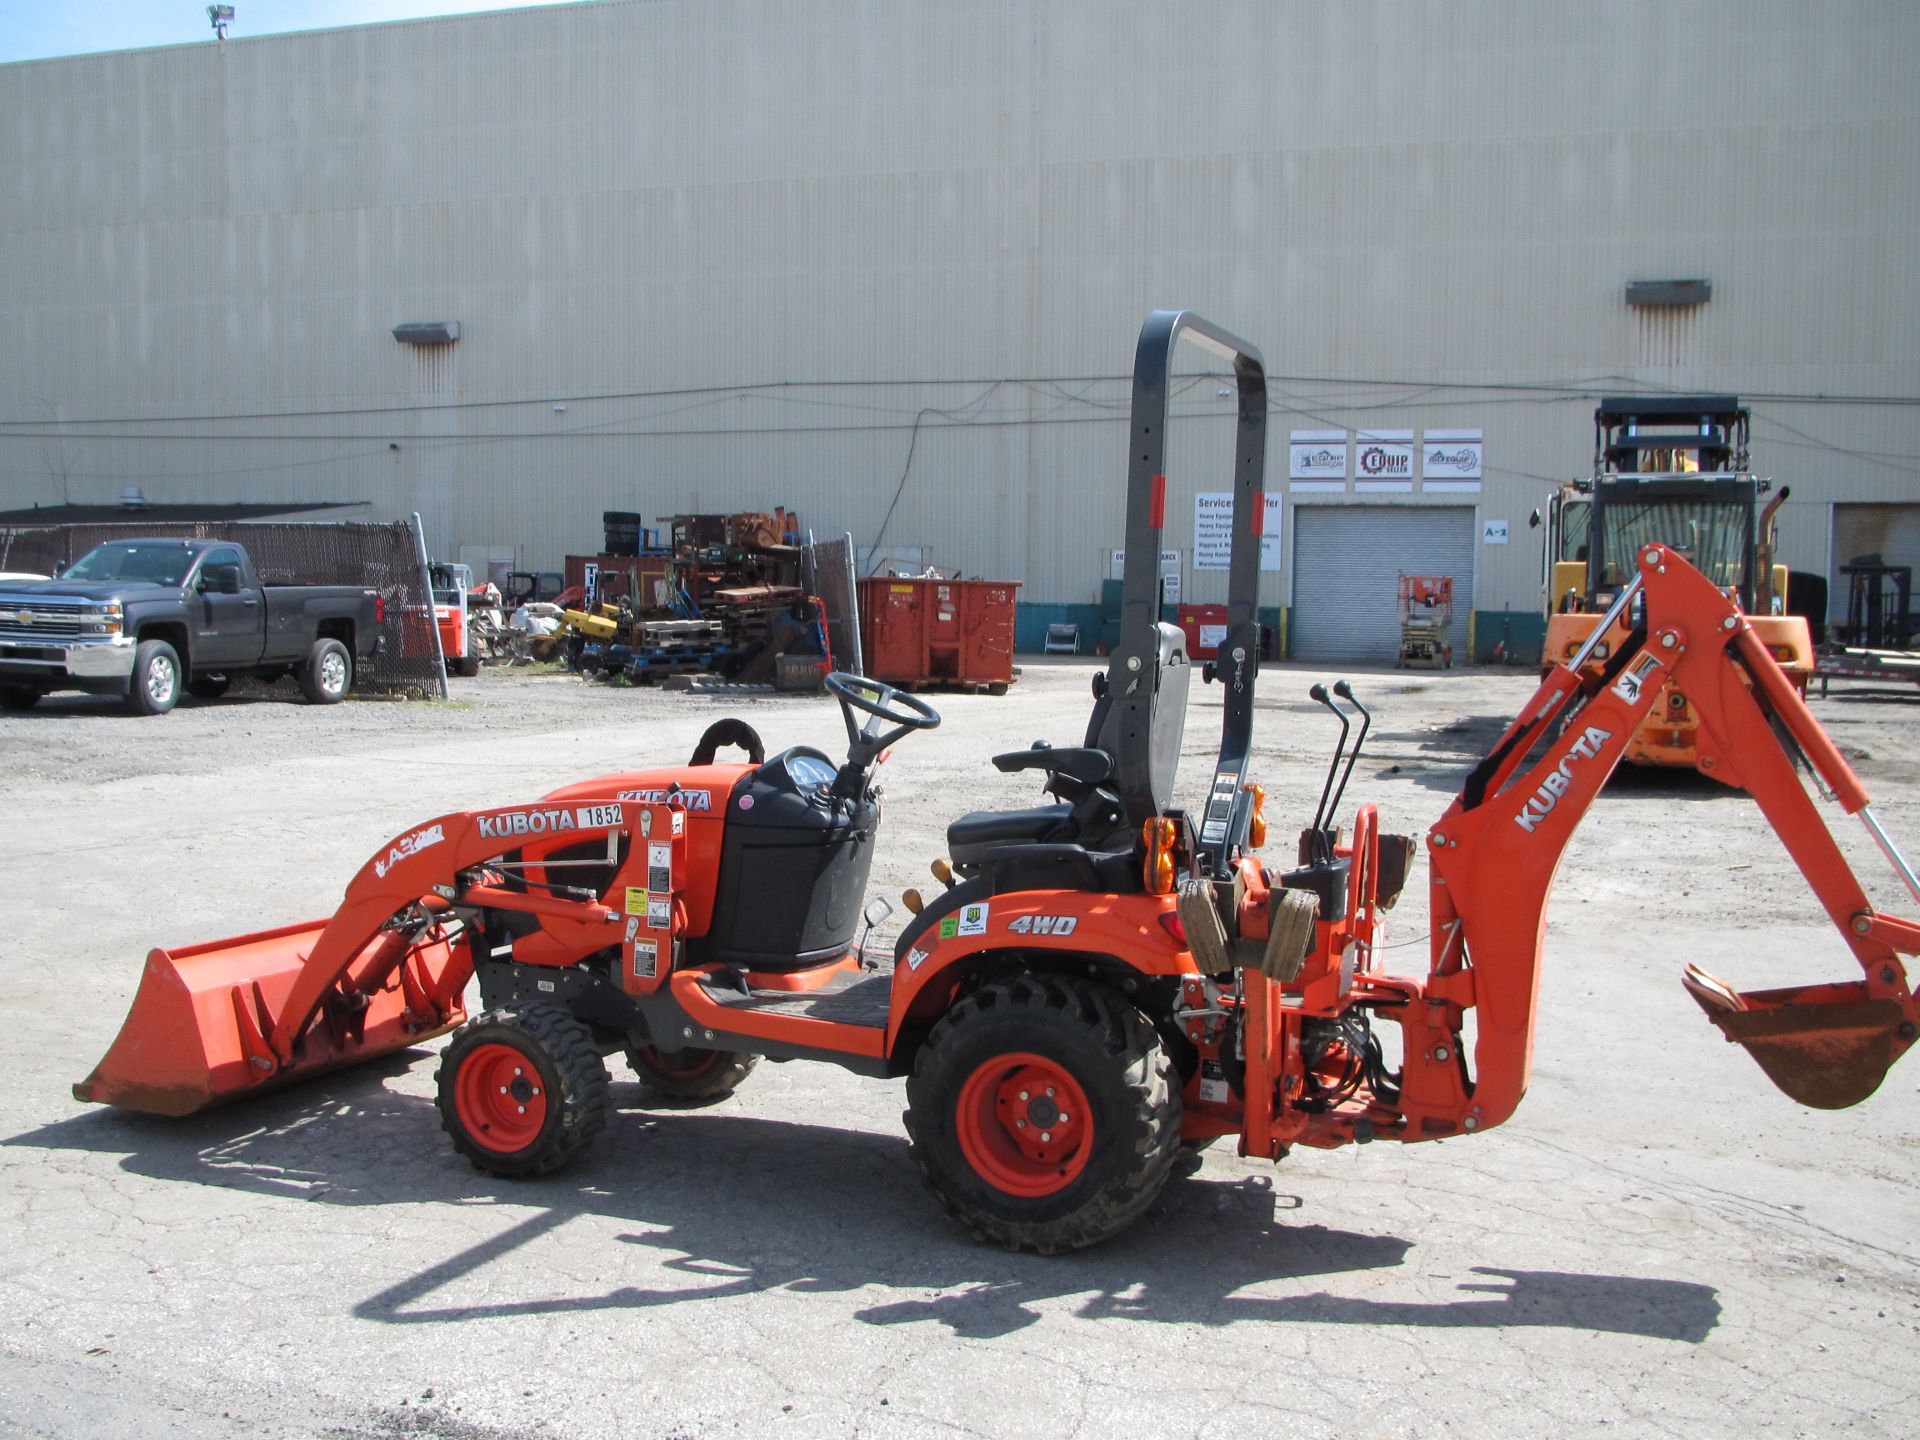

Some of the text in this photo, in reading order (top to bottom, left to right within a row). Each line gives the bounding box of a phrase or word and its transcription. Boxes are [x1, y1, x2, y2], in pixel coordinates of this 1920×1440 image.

[1371, 455, 1408, 467] EQUIP
[1198, 498, 1233, 508] Service
[1485, 527, 1507, 537] A-2
[1514, 726, 1613, 832] KUBOTA
[477, 809, 576, 839] KUBOTA
[586, 804, 622, 826] 1852
[374, 824, 446, 879] LA3
[1007, 914, 1078, 936] 4WD
